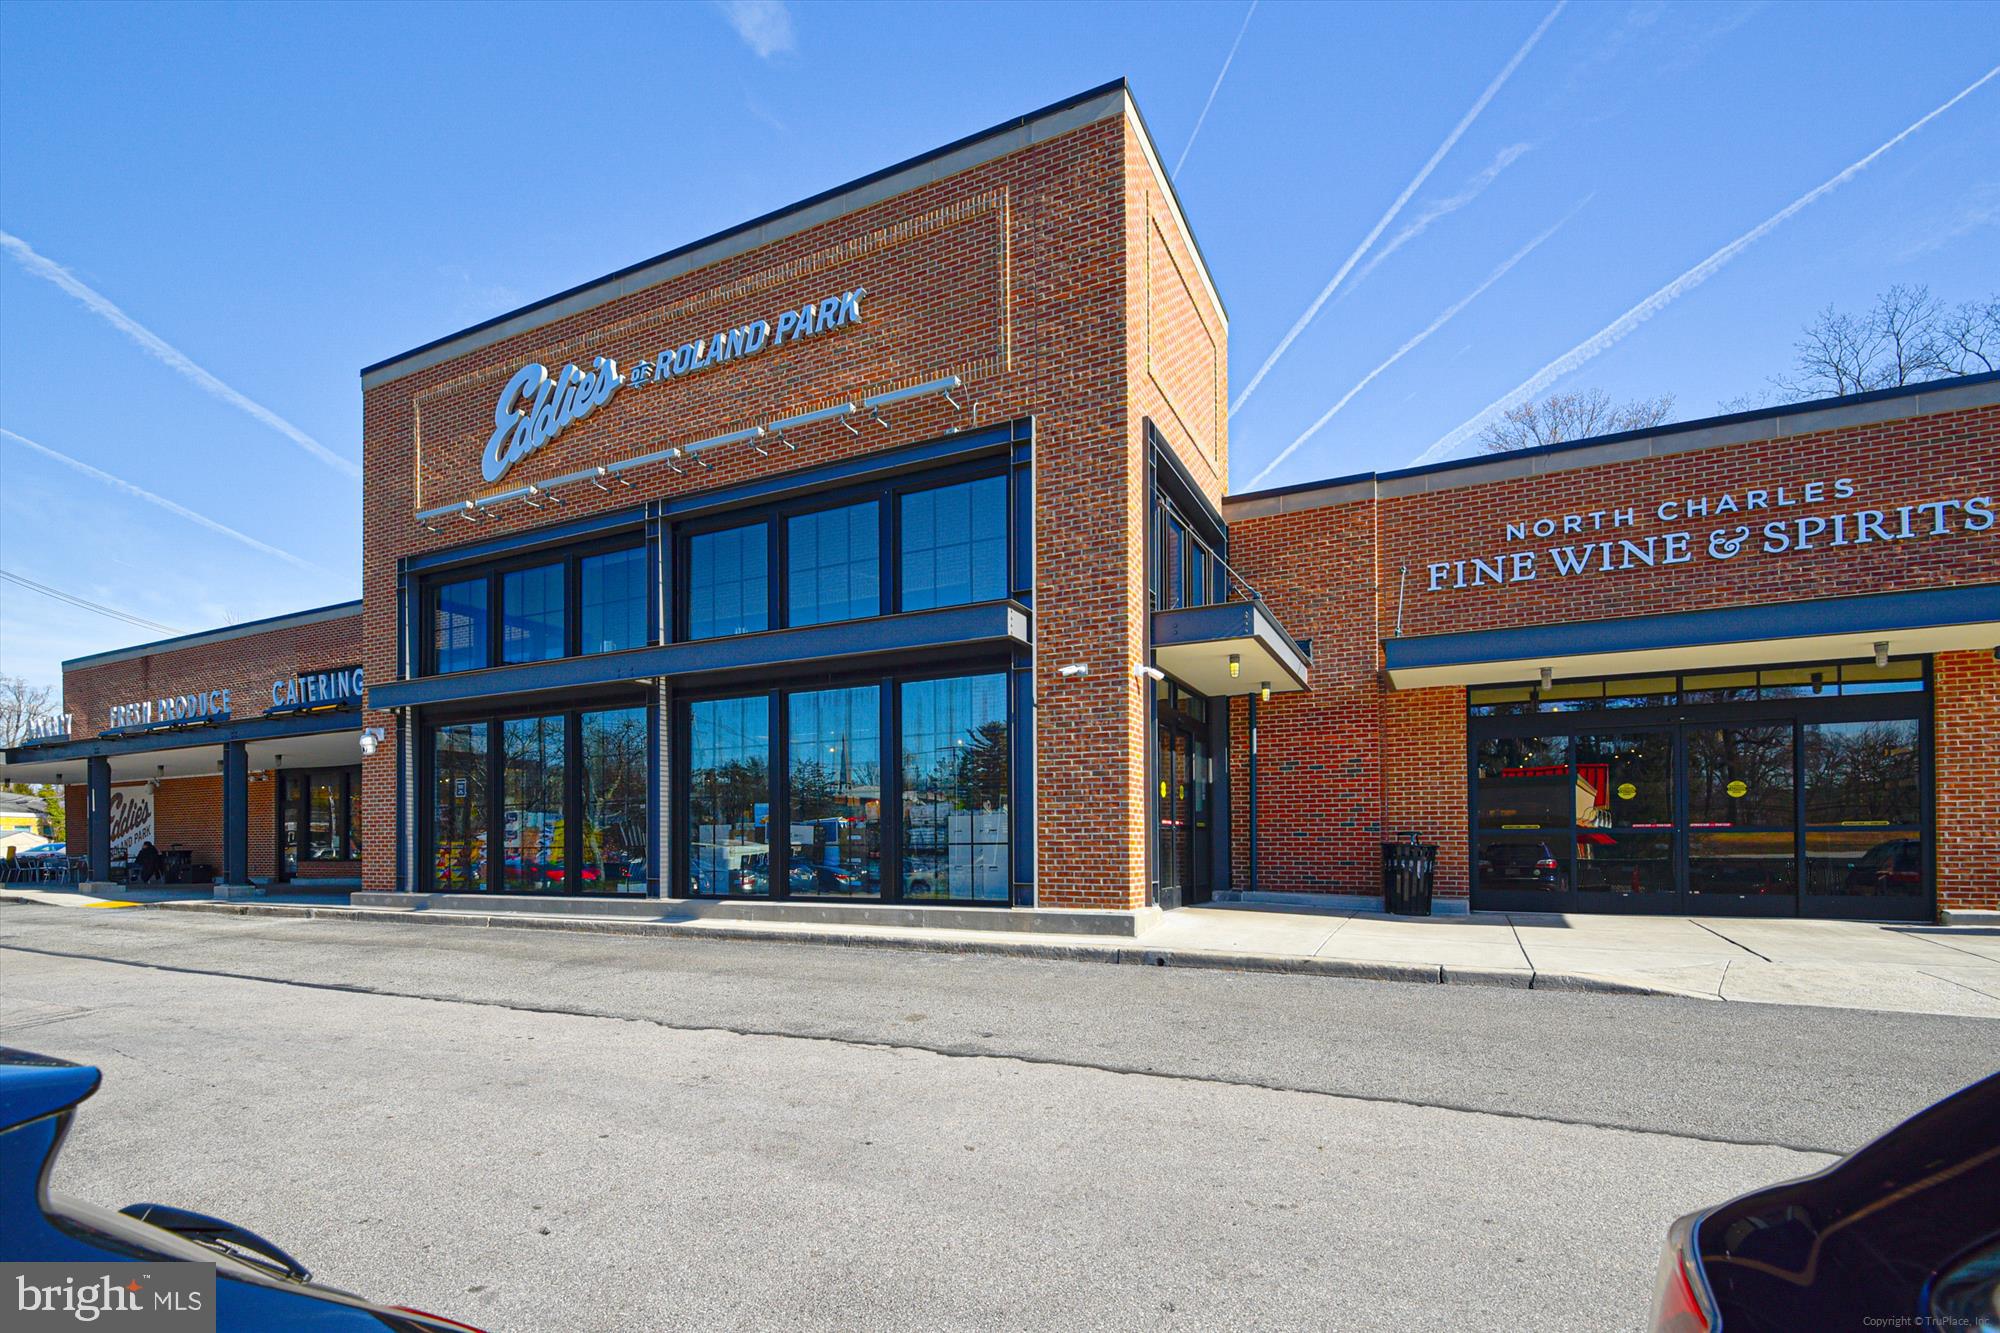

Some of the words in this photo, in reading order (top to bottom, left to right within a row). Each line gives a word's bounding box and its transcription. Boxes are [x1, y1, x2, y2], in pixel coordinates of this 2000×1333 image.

[482, 356, 625, 483] Eddie's
[654, 319, 771, 381] ROLAND
[775, 288, 867, 344] PARK
[1507, 507, 1634, 542] NORTH
[1658, 478, 1854, 522] CHARLES
[1427, 552, 1536, 592] FINE
[1548, 530, 1693, 577] WINE
[1708, 526, 1750, 560] &
[1763, 497, 1994, 554] SPIRITS
[110, 701, 151, 728] FRESH
[158, 690, 232, 722] PRODUCE
[272, 668, 363, 706] CATERING
[134, 825, 151, 844] PARK
